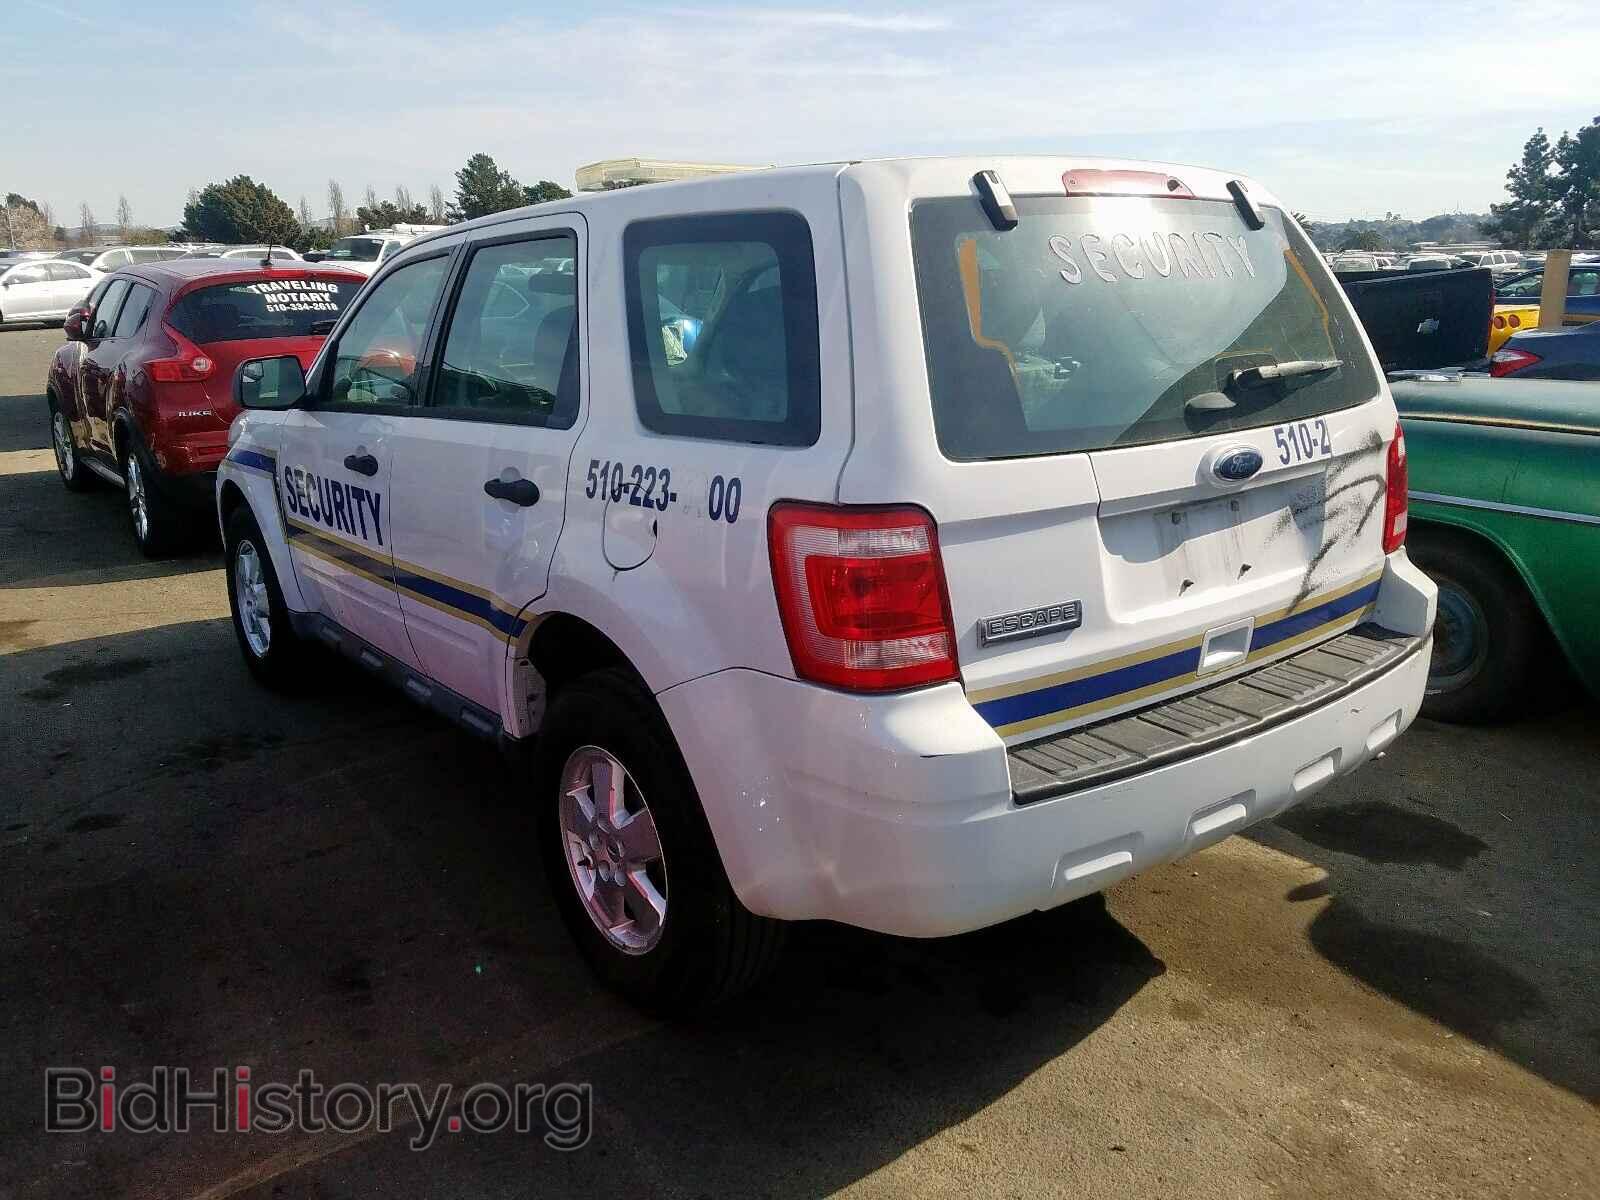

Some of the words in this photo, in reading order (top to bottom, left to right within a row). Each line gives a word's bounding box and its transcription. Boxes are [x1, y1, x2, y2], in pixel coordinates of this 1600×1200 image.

[1048, 231, 1255, 284] SECURITY
[247, 281, 338, 294] TRAVELING
[264, 292, 331, 303] NOTARY
[1273, 419, 1331, 465] 510-2
[284, 465, 384, 546] SECURITY
[708, 475, 742, 523] 00
[988, 603, 1077, 635] ESCAPE
